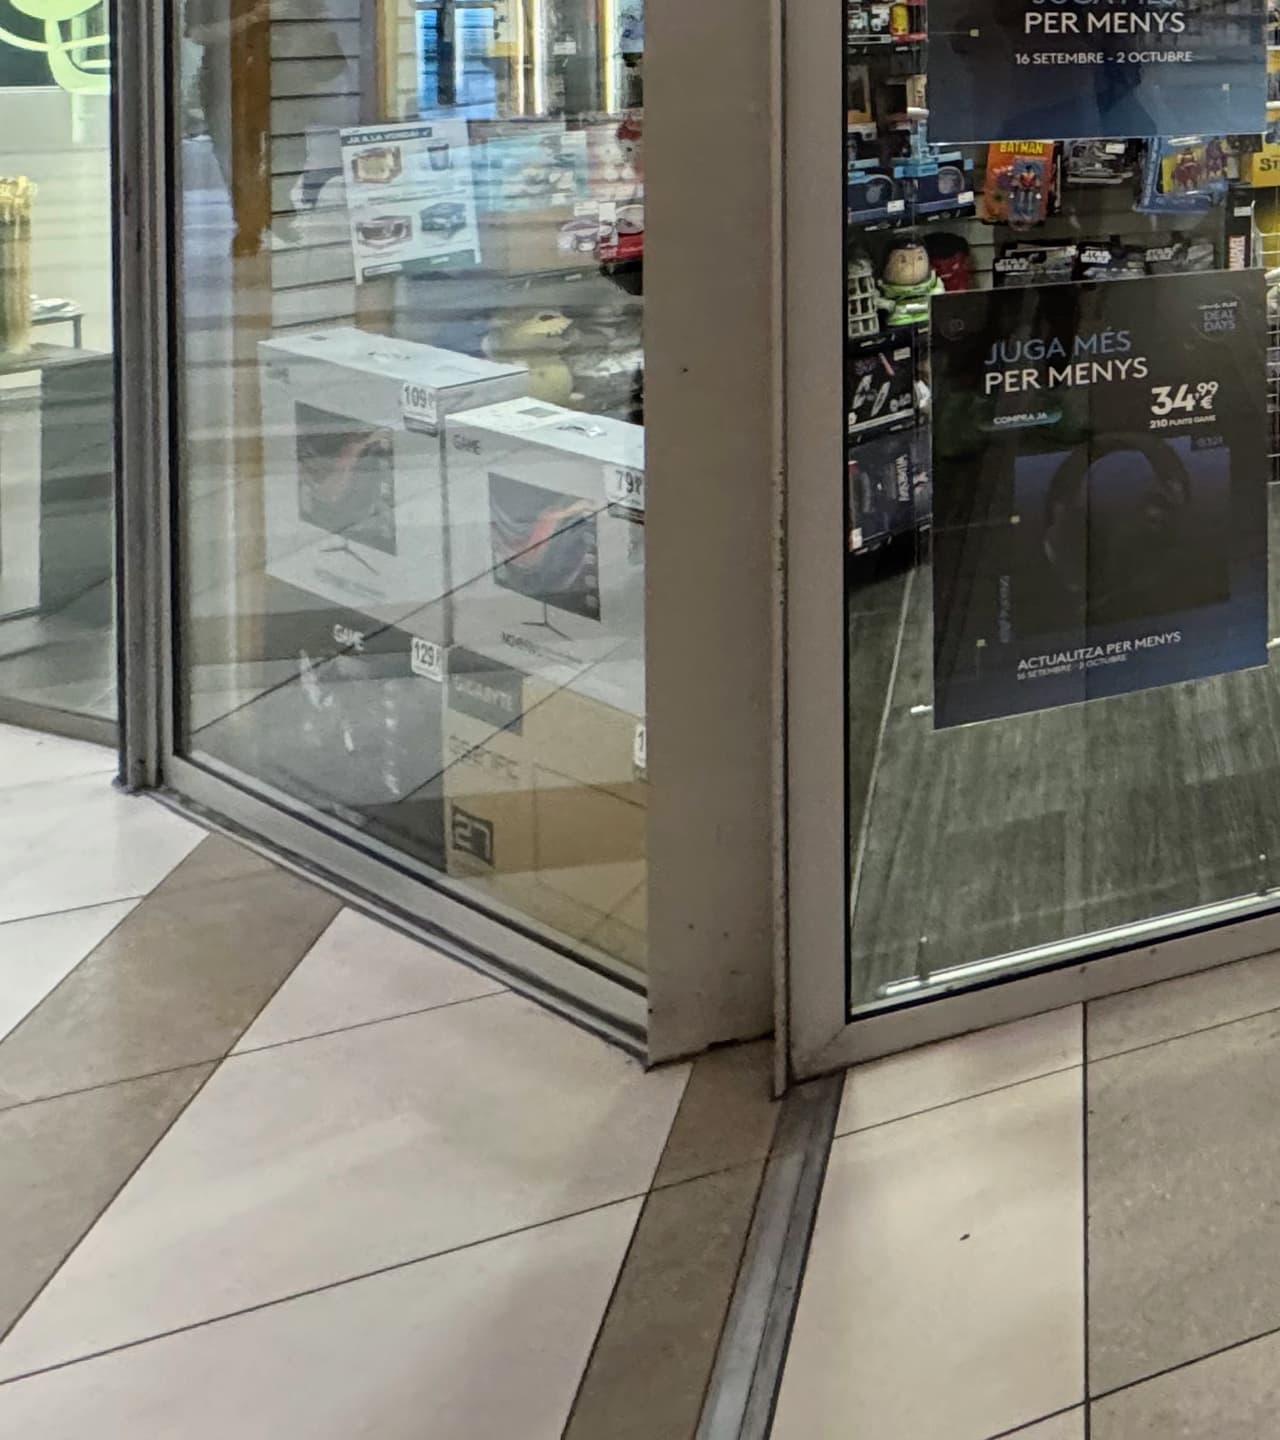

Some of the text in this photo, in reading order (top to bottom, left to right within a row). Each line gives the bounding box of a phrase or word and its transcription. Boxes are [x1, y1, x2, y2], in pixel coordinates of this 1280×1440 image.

[1025, 11, 1185, 34] PER MENYS
[1016, 50, 1193, 65] 16 SETEMBRE 2 OCTUBRE
[1000, 141, 1043, 156] BATMAN
[1204, 320, 1236, 332] DAYS
[984, 327, 1132, 365] JUGA MÉS
[985, 357, 1148, 395] PER MENYS
[993, 411, 1048, 425] COMPRA JA
[1150, 418, 1168, 429] 210
[1017, 630, 1182, 671] ACTUALITZA PER MENYS
